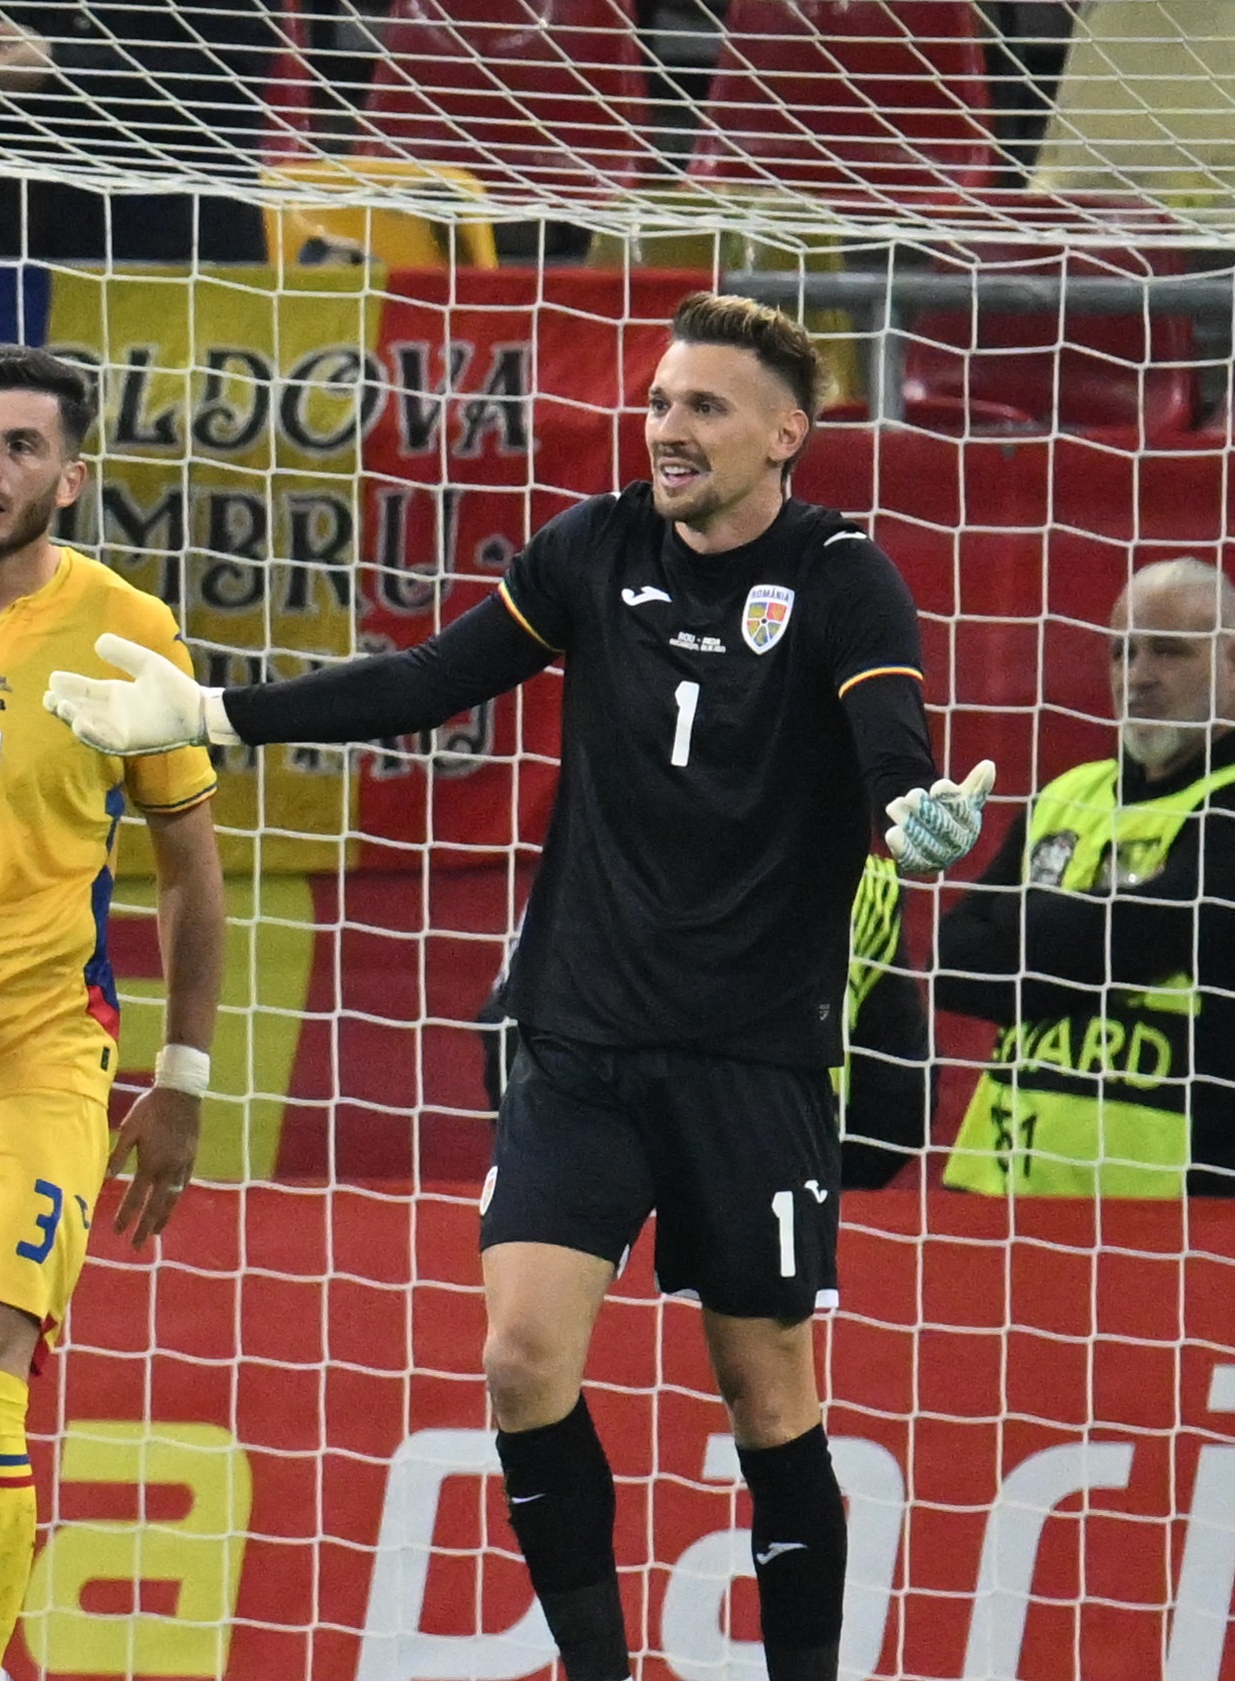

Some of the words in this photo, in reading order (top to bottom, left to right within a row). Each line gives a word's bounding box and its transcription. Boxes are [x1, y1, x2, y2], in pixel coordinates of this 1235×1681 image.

[671, 680, 700, 767] 1
[16, 1179, 63, 1264] 3
[771, 1191, 796, 1277] 1
